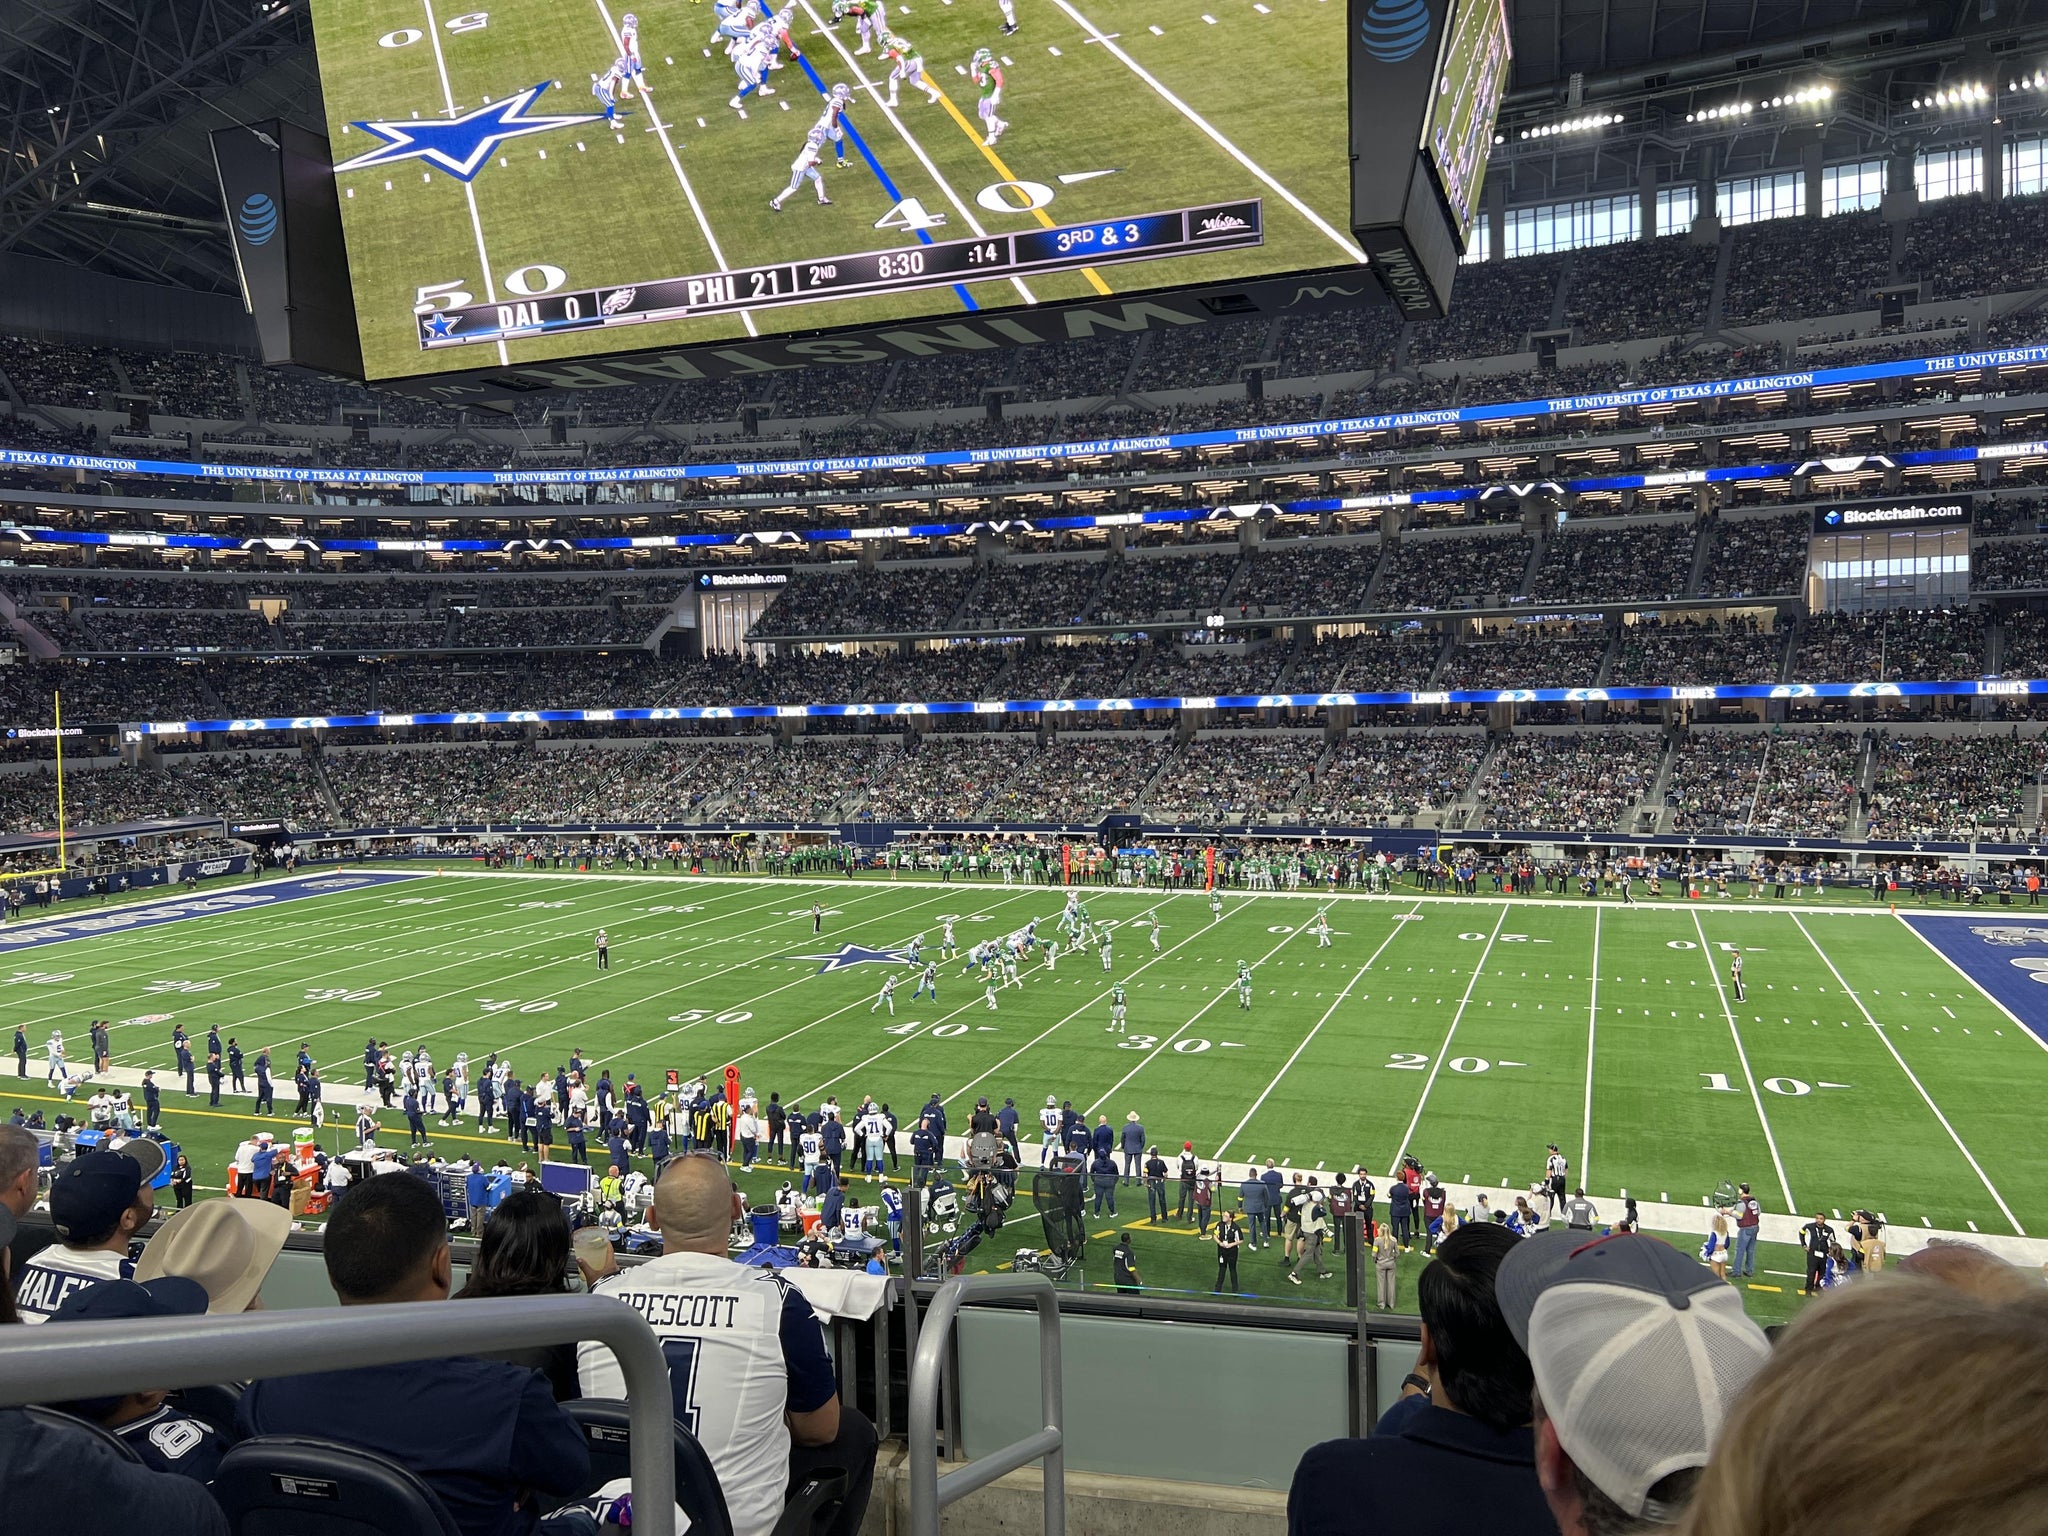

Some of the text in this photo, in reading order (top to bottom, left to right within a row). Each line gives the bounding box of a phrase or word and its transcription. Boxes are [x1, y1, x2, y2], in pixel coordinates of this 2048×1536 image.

[1057, 223, 1140, 252] 3RD & 3
[968, 243, 998, 263] :14
[809, 251, 924, 285] 2ND 8:30
[687, 270, 779, 305] PHI 21
[1376, 248, 1431, 310] WINSTAR
[499, 297, 580, 328] DAL 0
[1925, 348, 2048, 370] THE UNIVERSITY
[1548, 375, 1813, 410] THE UNIVERSITY OF TEXAS AT ARLINGTON
[1236, 412, 1460, 439] THE UNIVERSITY OF TEXAS AT ARLINGTON
[1714, 426, 1739, 434] WARE
[970, 438, 1170, 460] THE UNIVERSITY OF TEXAS AT ARLINGTON
[9, 453, 47, 463] TEXAS
[50, 456, 64, 464] AT
[68, 458, 136, 469] ARLINGTON
[737, 456, 925, 473] THE UNIVERSITY OF TEXAS AT ARLINGTON
[201, 466, 423, 481] THE UNIVERSITY OF TEXAS AT ARLINGTON
[515, 473, 572, 481] UNIVERSITY
[574, 472, 587, 480] OF
[589, 472, 617, 480] TEXAS
[632, 469, 685, 478] ARLINGTON
[1844, 505, 1962, 523] Blockchain.com
[712, 573, 787, 585] Blockchain.com
[304, 989, 382, 1002] 30
[668, 1008, 753, 1024] 50
[884, 1020, 969, 1037] 40
[1117, 1034, 1212, 1054] 30
[1384, 1053, 1490, 1074] 20
[668, 1072, 677, 1083] 3
[1700, 1073, 1811, 1096] 10
[868, 1121, 879, 1133] 71
[1046, 1114, 1056, 1126] 10
[803, 1141, 816, 1153] 90
[844, 1213, 860, 1228] 54
